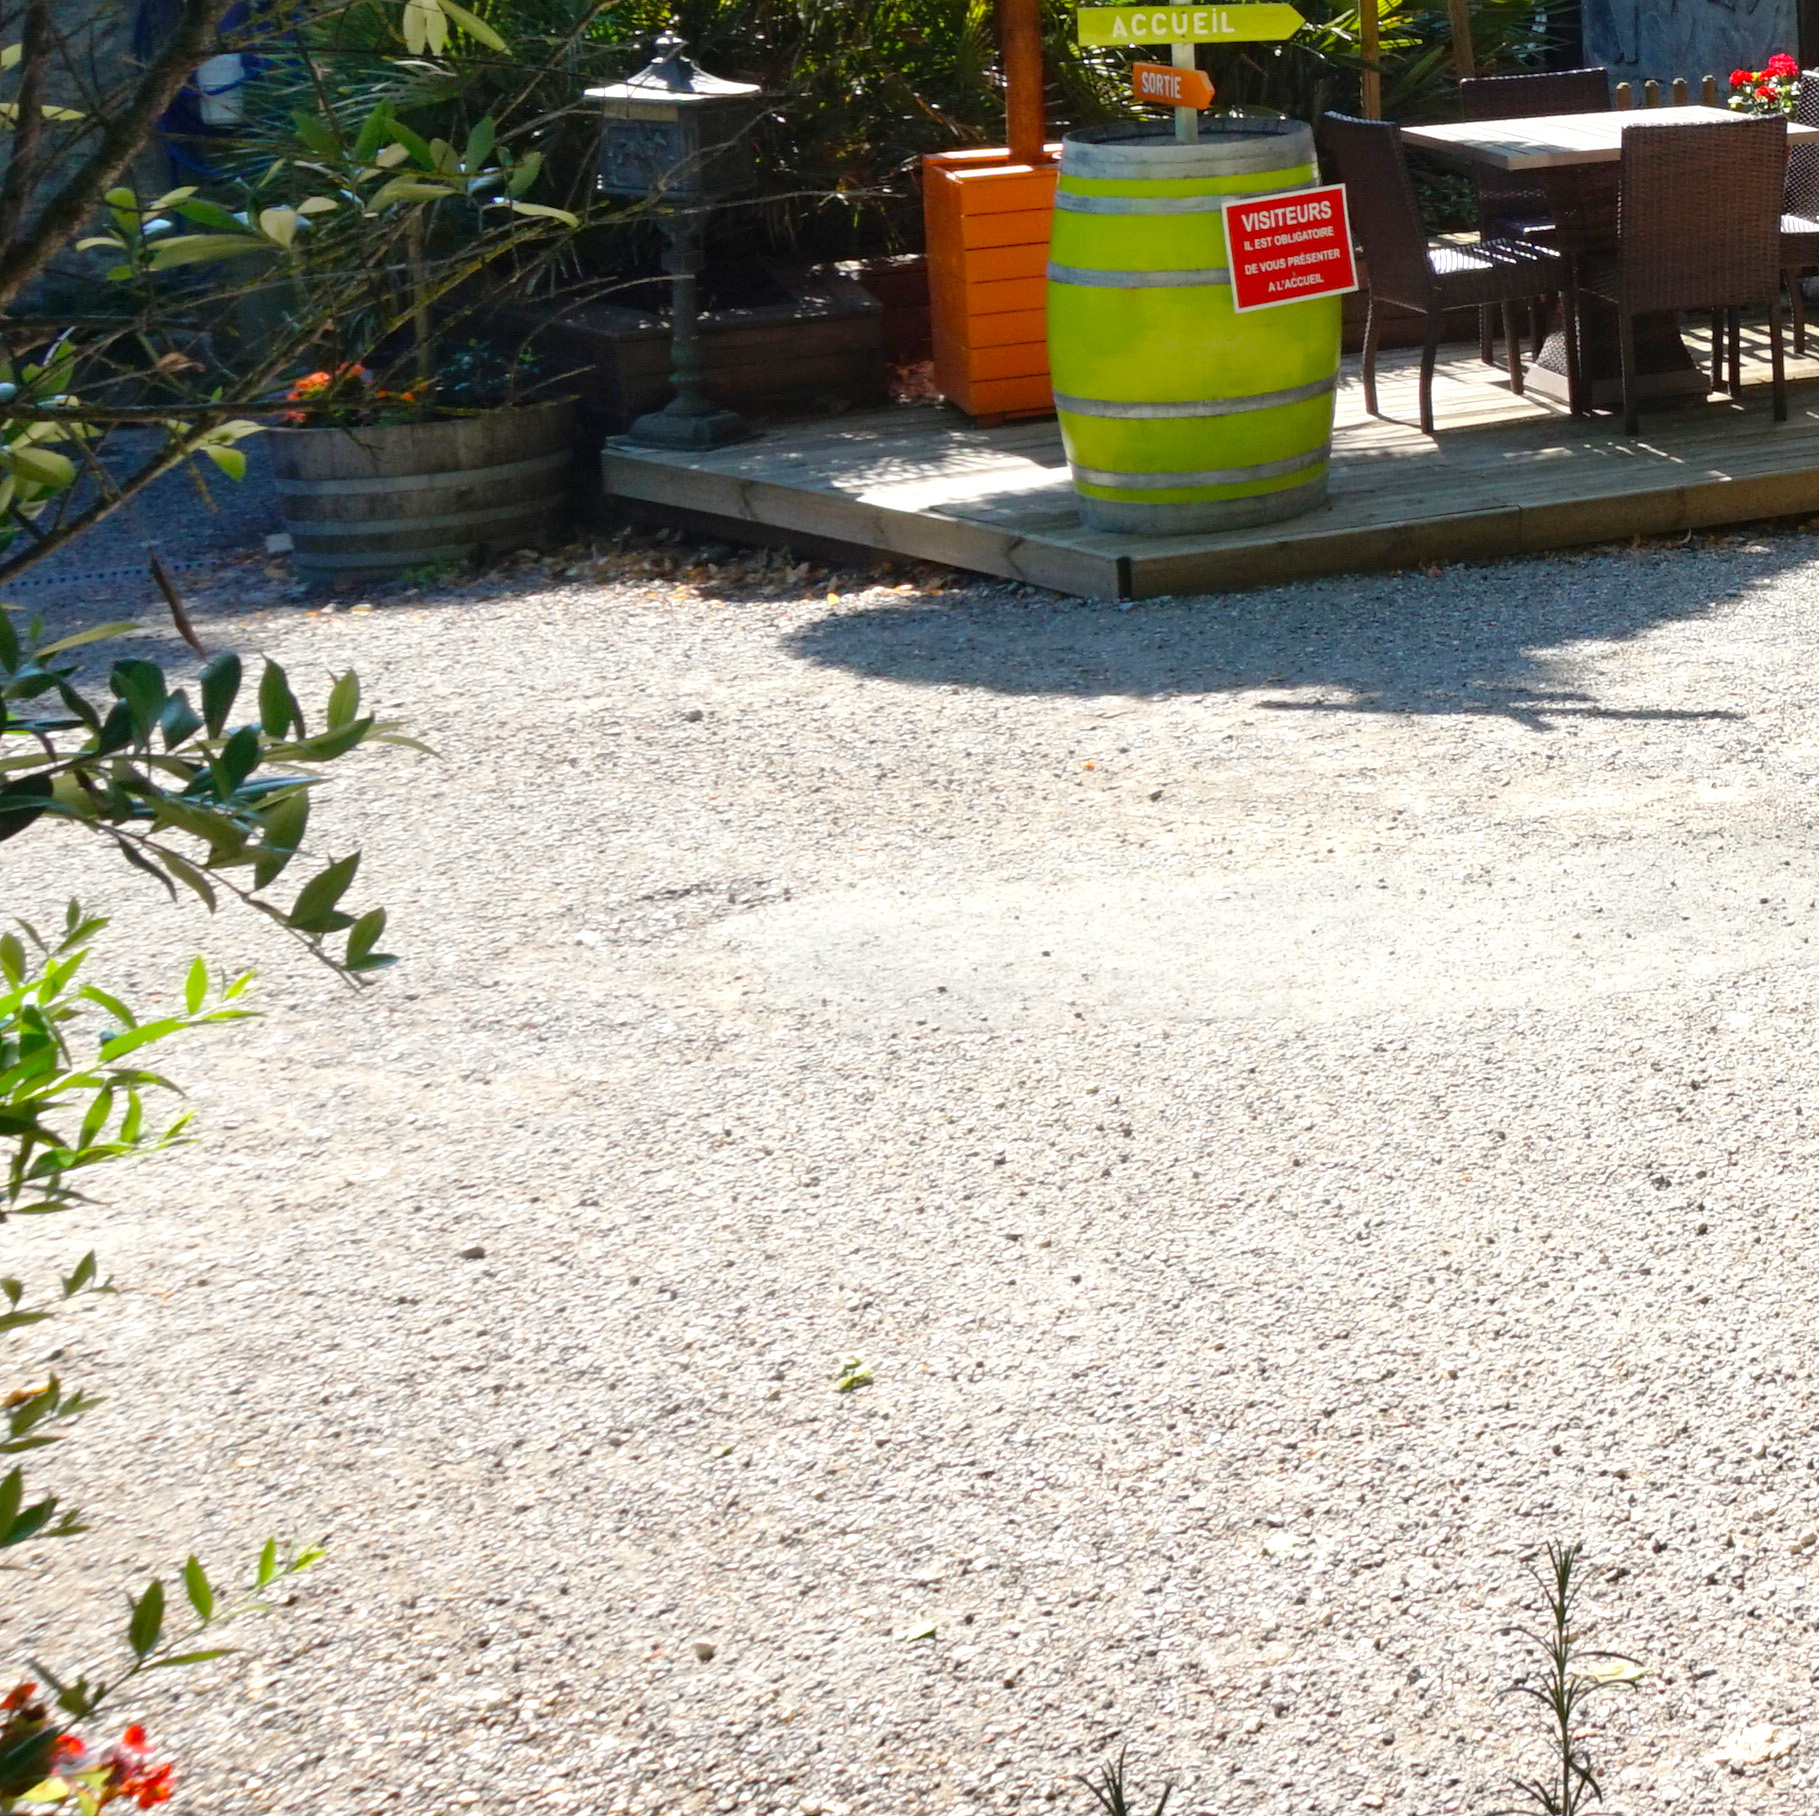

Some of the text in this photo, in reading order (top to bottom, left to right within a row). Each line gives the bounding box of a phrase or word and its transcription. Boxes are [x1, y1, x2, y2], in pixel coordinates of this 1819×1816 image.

[1241, 200, 1332, 232] VISITEURS
[1243, 225, 1334, 251] IL EST OBLIGATOIRE
[1244, 263, 1259, 275] DE
[1259, 258, 1287, 272] VOUS
[1276, 273, 1324, 291] L'ACCUEIL
